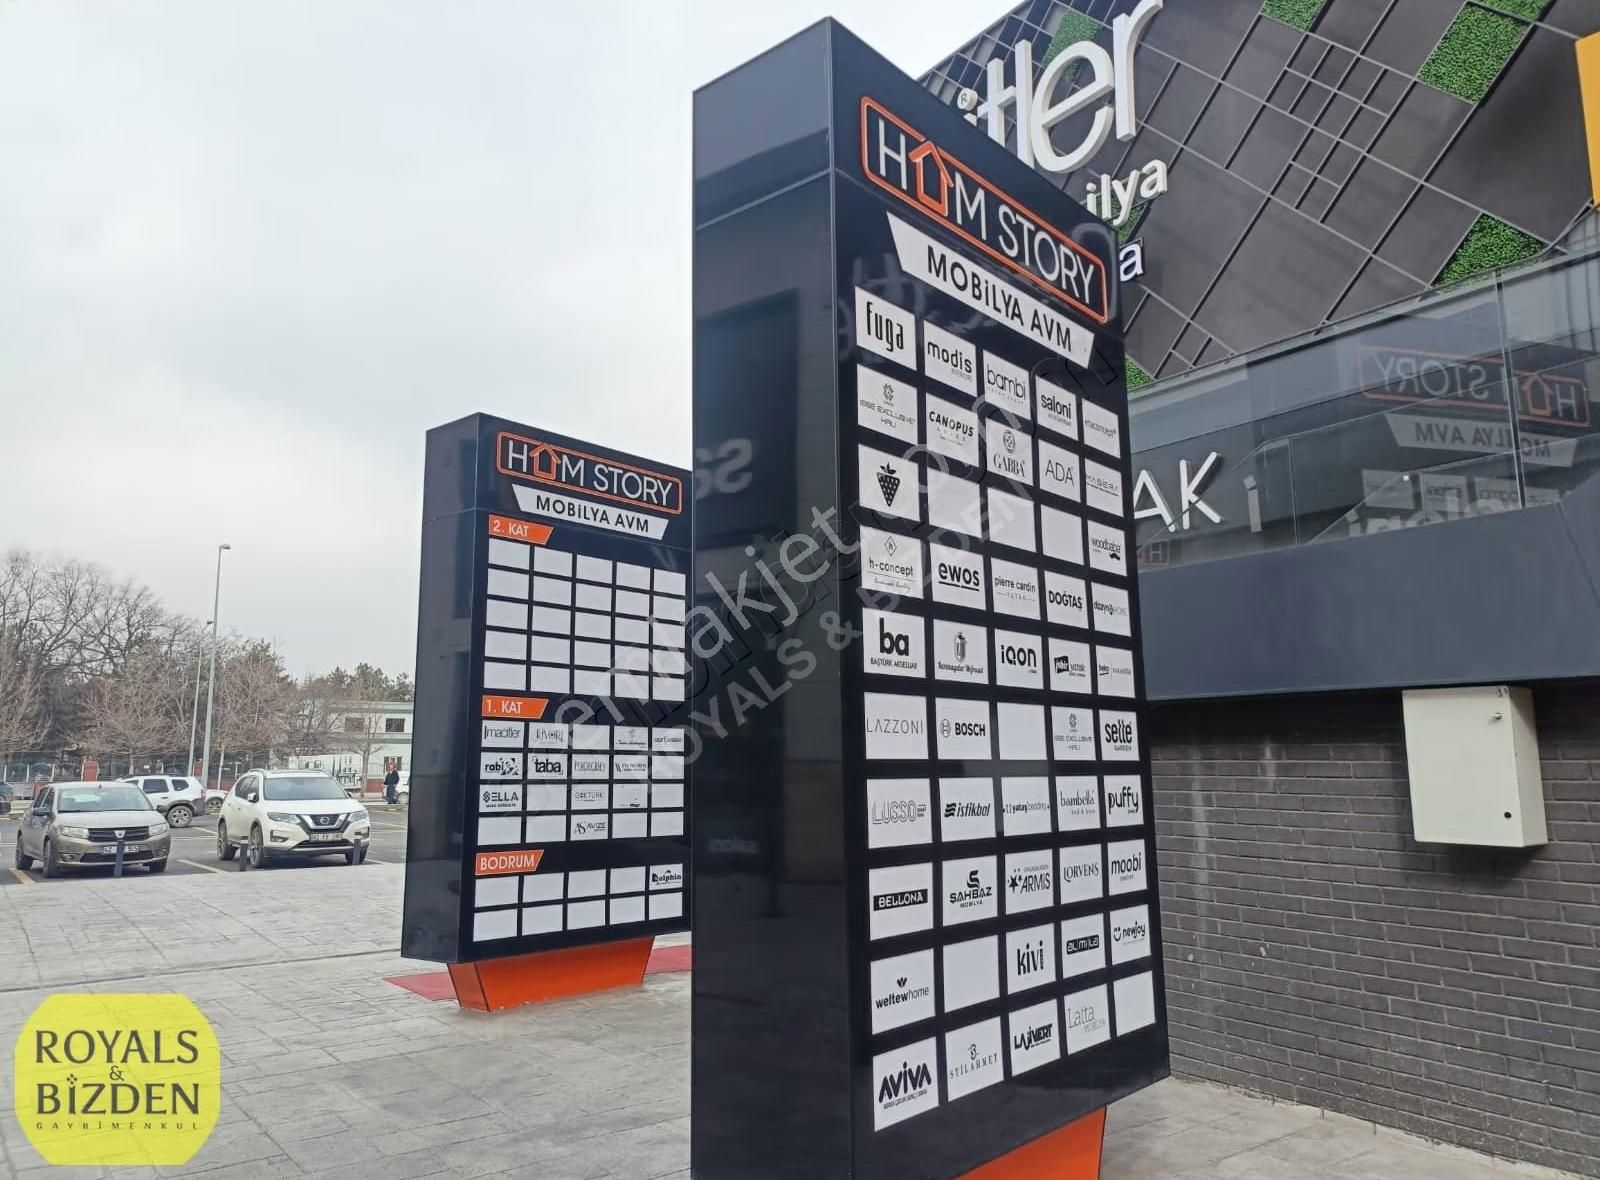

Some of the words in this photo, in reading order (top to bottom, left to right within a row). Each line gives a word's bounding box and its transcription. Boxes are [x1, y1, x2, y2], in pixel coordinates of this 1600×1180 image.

[957, 0, 1163, 174] tler
[998, 204, 1094, 304] STORY
[866, 301, 904, 352] fuga
[1030, 309, 1071, 352] AVM
[927, 341, 973, 373] modis
[987, 364, 1025, 398] bambi
[1041, 394, 1072, 420] saloni
[929, 411, 974, 437] CANOPUS
[593, 463, 673, 506] STORY
[1045, 459, 1074, 487] ADA
[493, 520, 504, 533] 2.
[508, 522, 529, 538] KAT
[614, 513, 649, 533] AVM
[869, 557, 914, 577] h-concept
[938, 562, 980, 587] ewos
[994, 575, 1015, 590] pierre
[1016, 580, 1036, 593] cardin
[879, 617, 909, 656] ba
[486, 699, 497, 713] 1.
[501, 701, 523, 714] KAT
[955, 722, 986, 737] BOSCH
[534, 758, 562, 773] taba
[872, 800, 916, 825] LUSSO
[1107, 786, 1139, 815] puffy
[480, 854, 535, 871] BODRUM
[1111, 851, 1142, 875] moobi
[878, 892, 923, 908] BELLONA
[1122, 920, 1146, 940] newjoy
[1016, 940, 1044, 976] kivi
